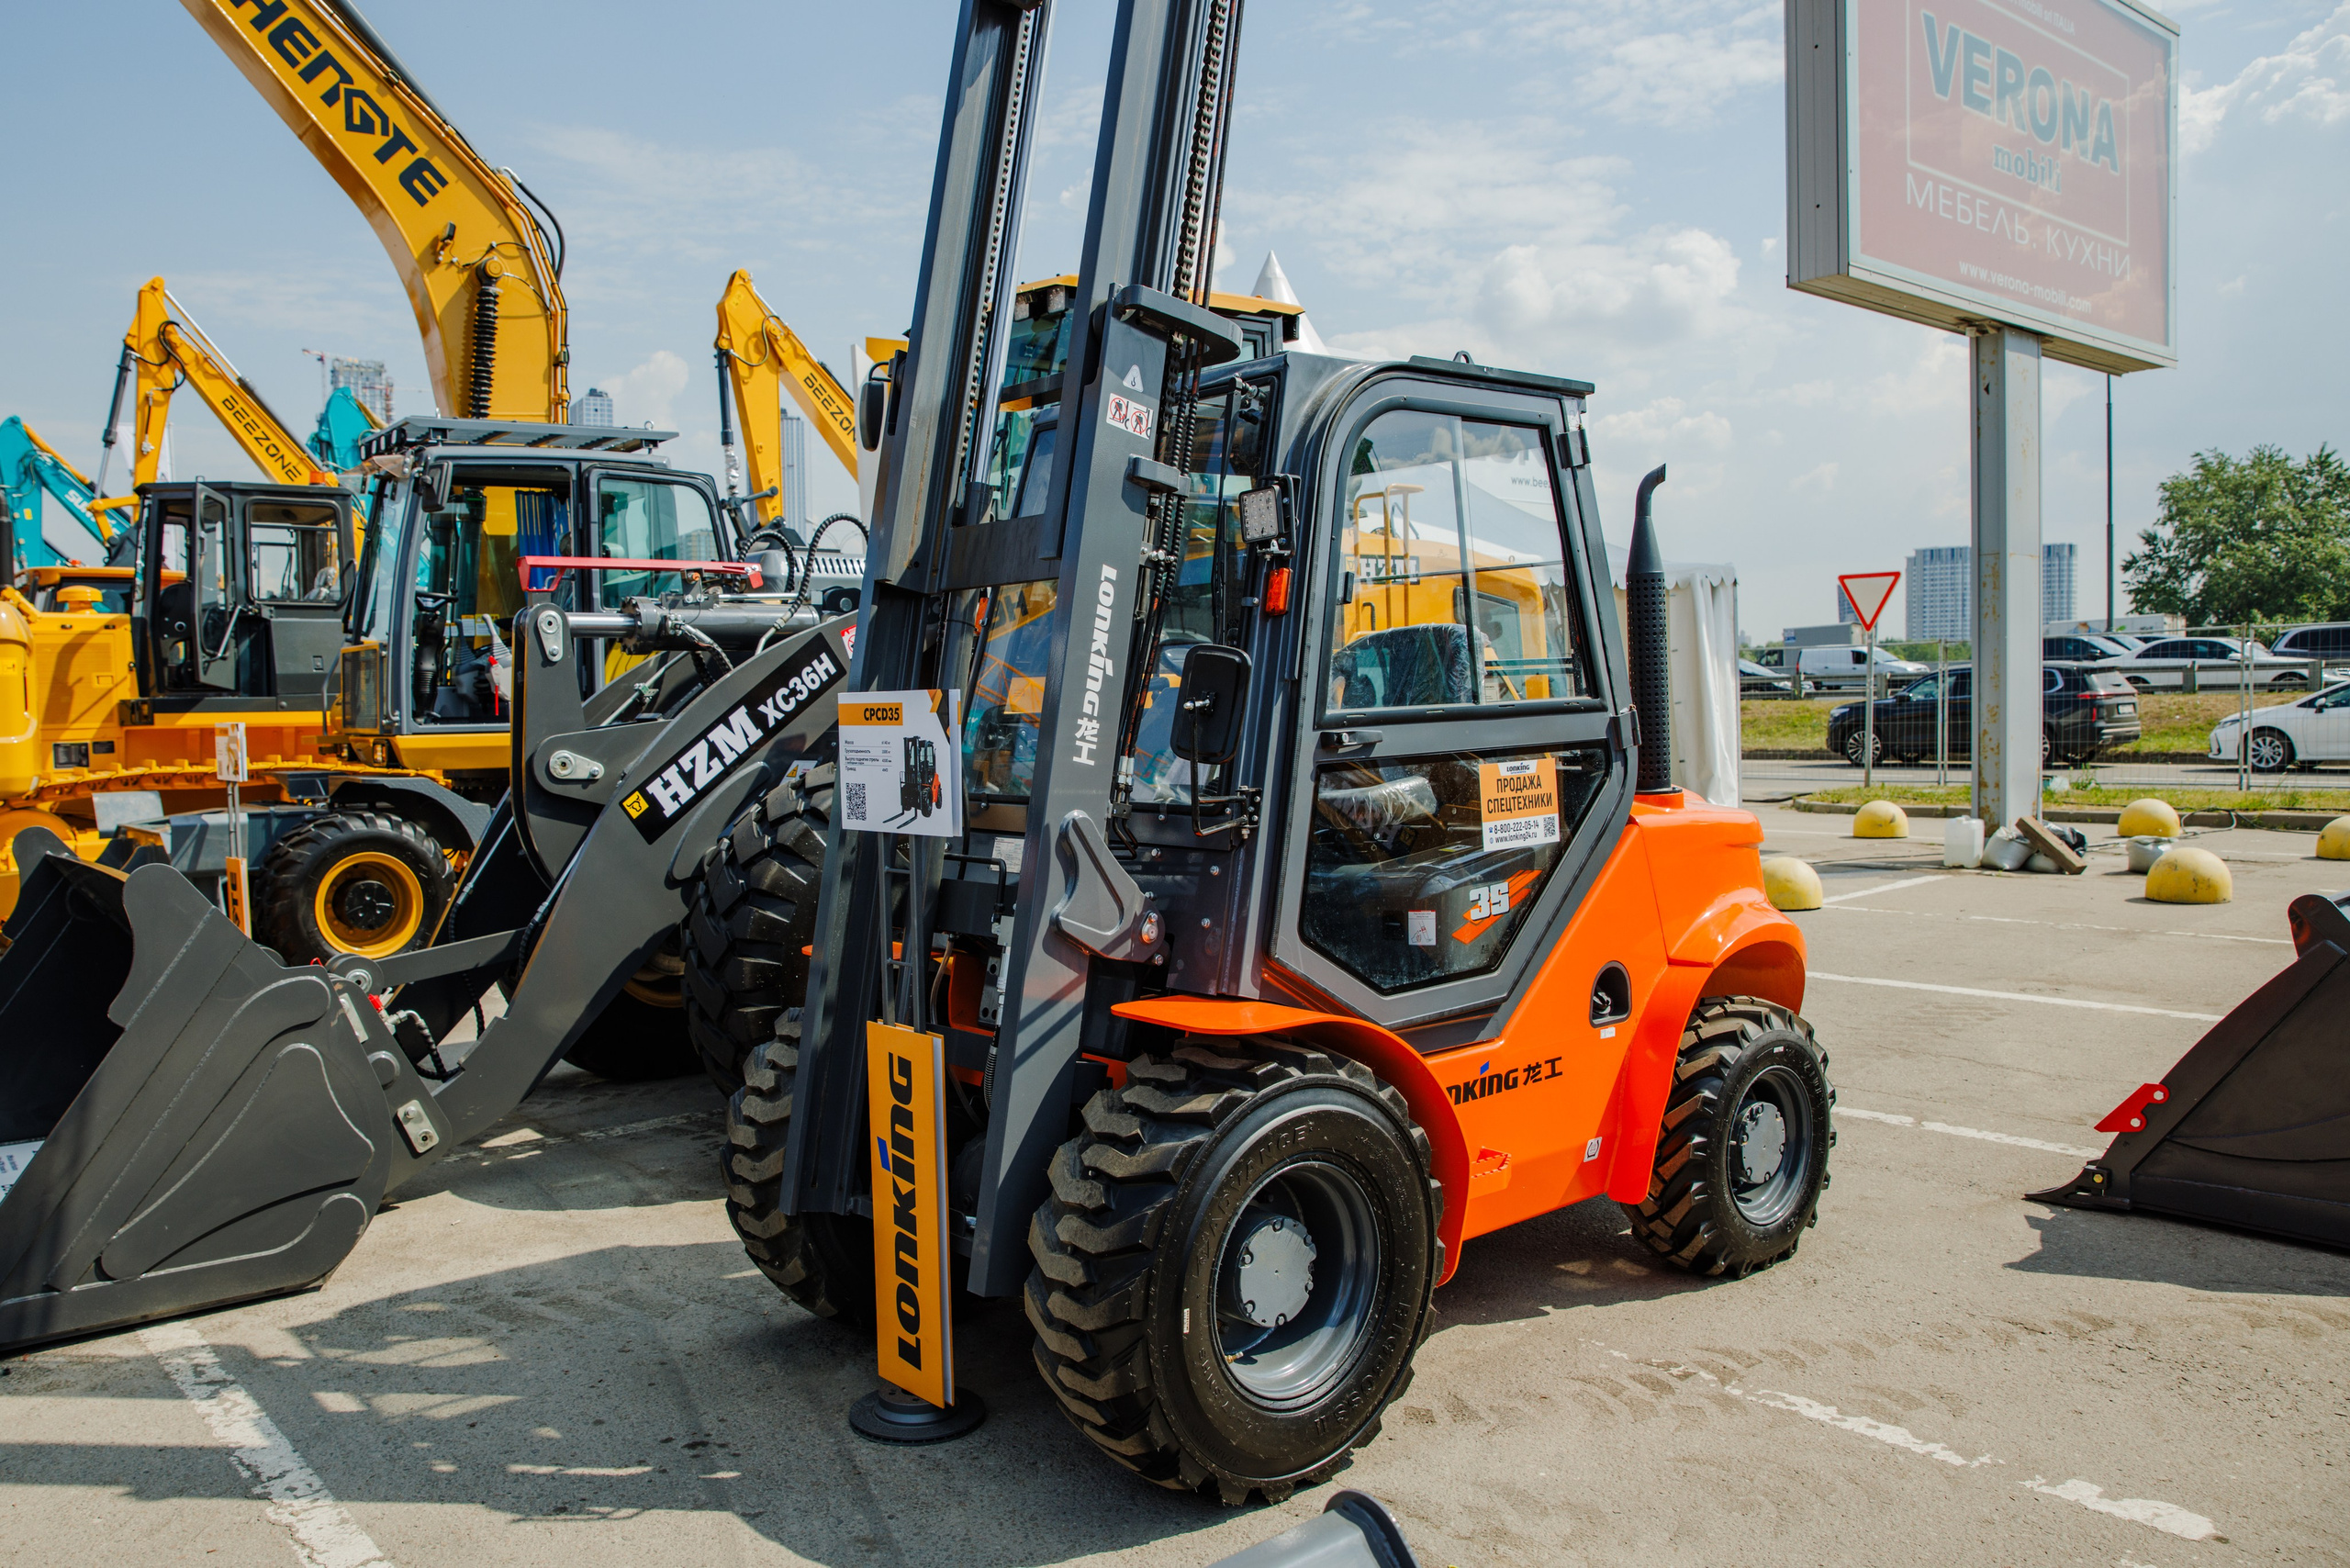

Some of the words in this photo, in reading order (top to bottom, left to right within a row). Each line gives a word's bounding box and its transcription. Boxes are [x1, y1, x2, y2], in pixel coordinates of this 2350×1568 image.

[1921, 9, 2120, 175] VERONA
[1993, 143, 2063, 196] mobili
[2045, 228, 2132, 283] КУХНИ
[1958, 260, 2093, 315] www.verona-mobili.com
[221, 395, 303, 483] BEEZONE
[645, 704, 764, 819] HZM
[757, 652, 837, 729] XC36H
[863, 707, 901, 722] CPCD35
[1487, 792, 1552, 813] СПЕЦТЕХНИКИ
[1496, 775, 1542, 794] ПРОДАЖА
[1494, 820, 1539, 834] 8-800-222-05-14
[1494, 832, 1538, 844] www.lonking24.ru
[1470, 881, 1510, 921] 35
[1446, 1060, 1519, 1106] NKING
[1209, 1125, 1306, 1238] ADVANCE
[877, 1051, 923, 1372] LONKING
